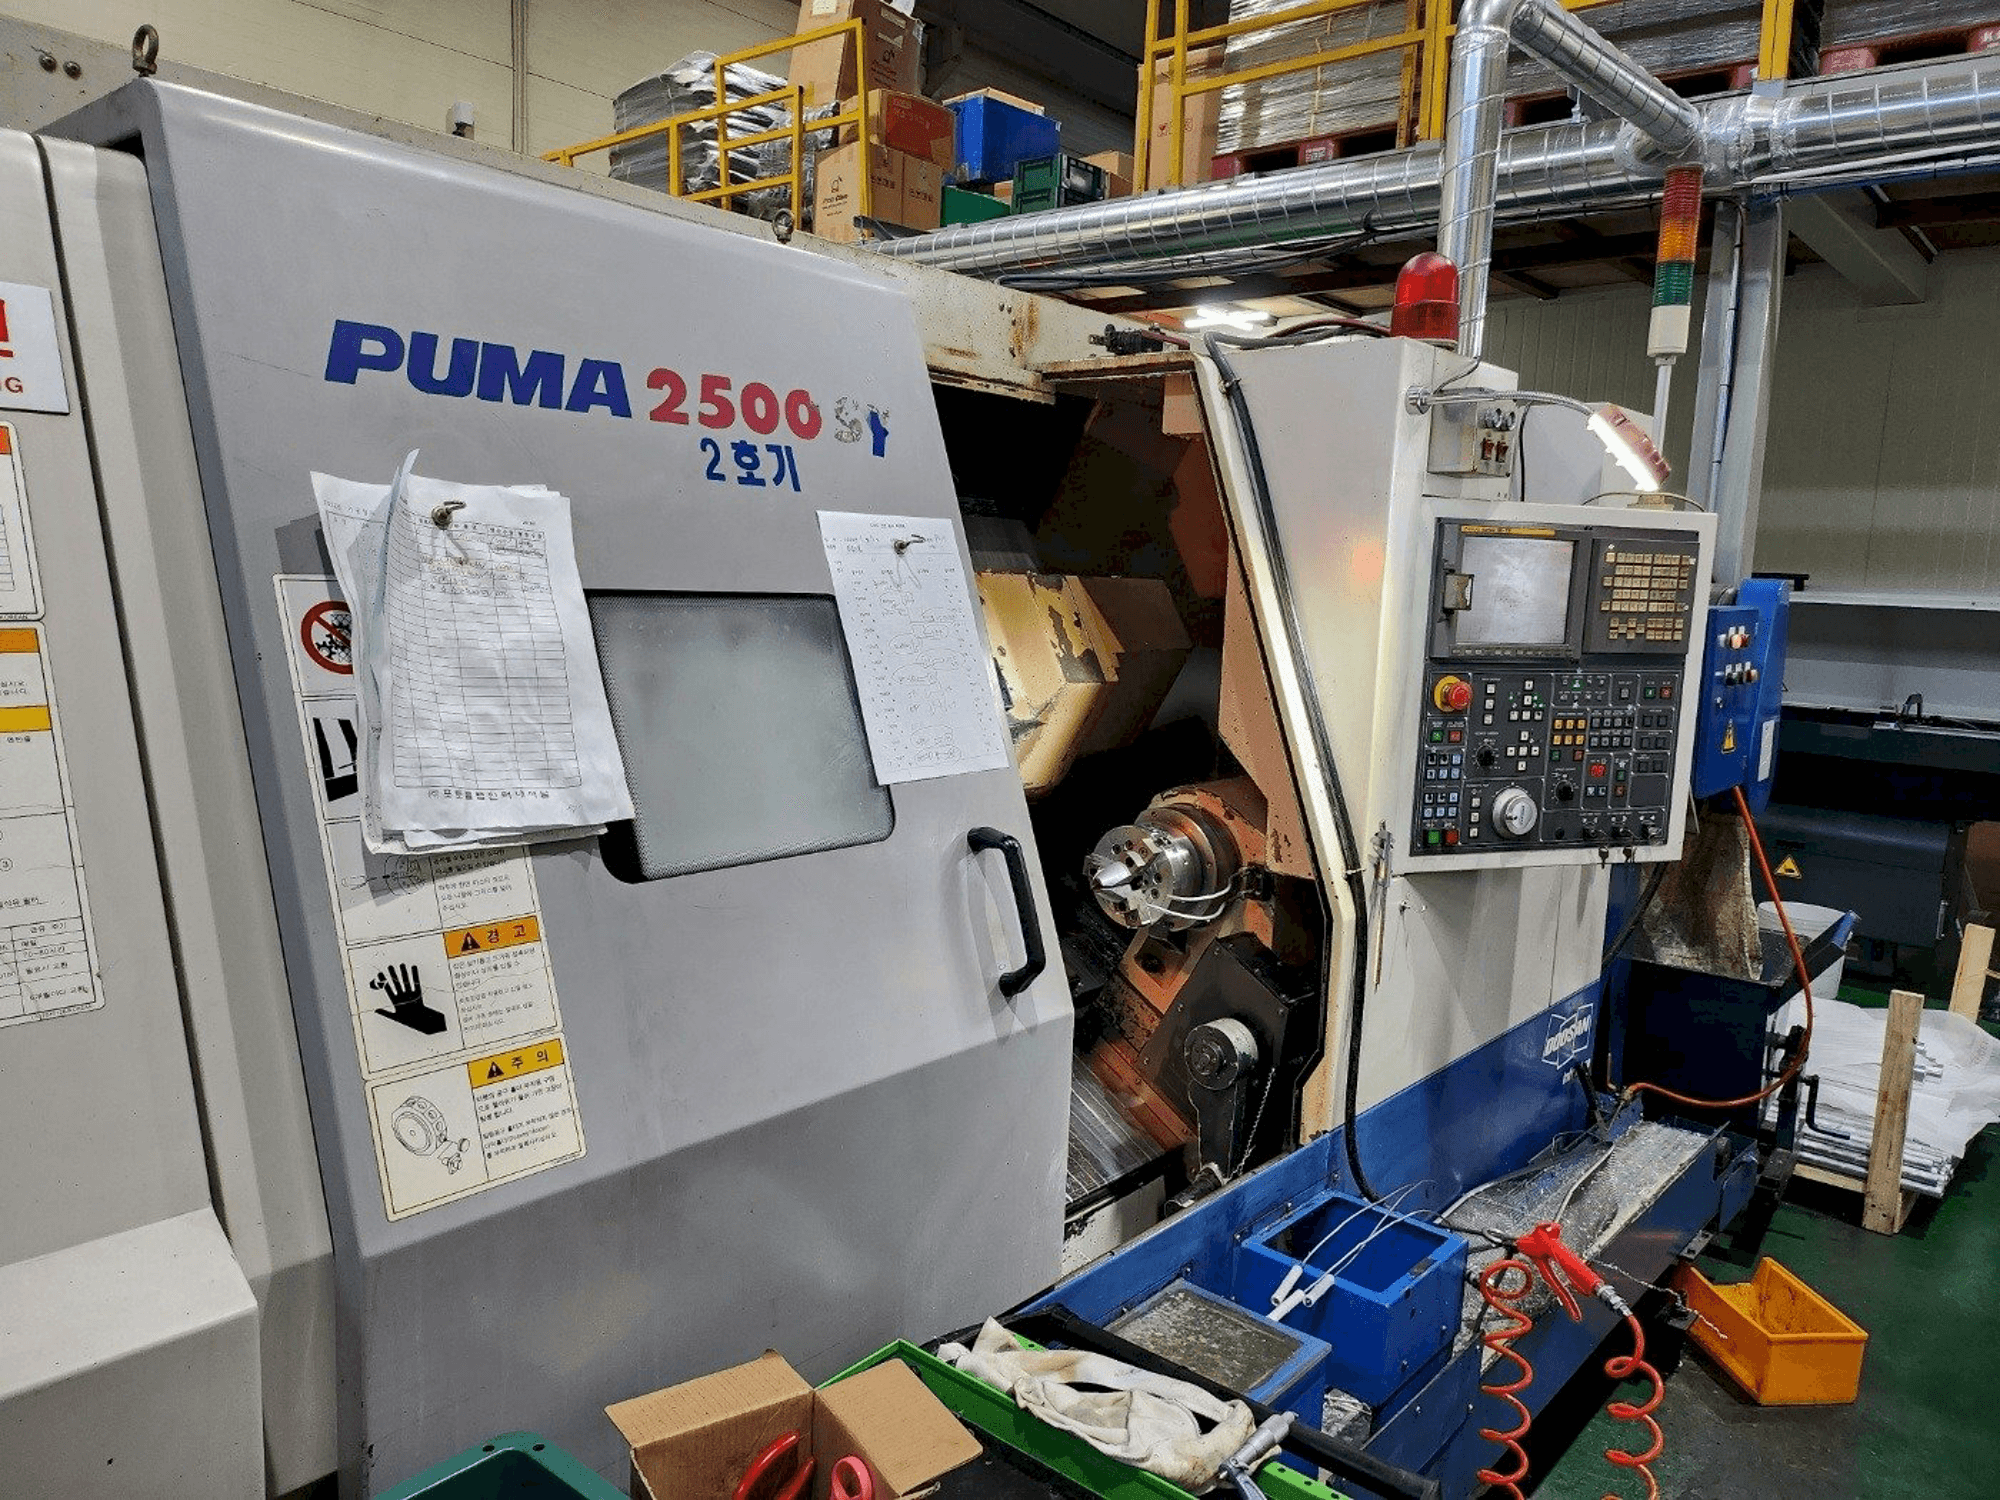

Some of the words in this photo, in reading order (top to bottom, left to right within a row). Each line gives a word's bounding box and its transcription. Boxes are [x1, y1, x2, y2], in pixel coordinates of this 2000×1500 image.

[324, 319, 633, 418] PUMA
[646, 367, 823, 441] 2500
[699, 437, 802, 493] 2호기
